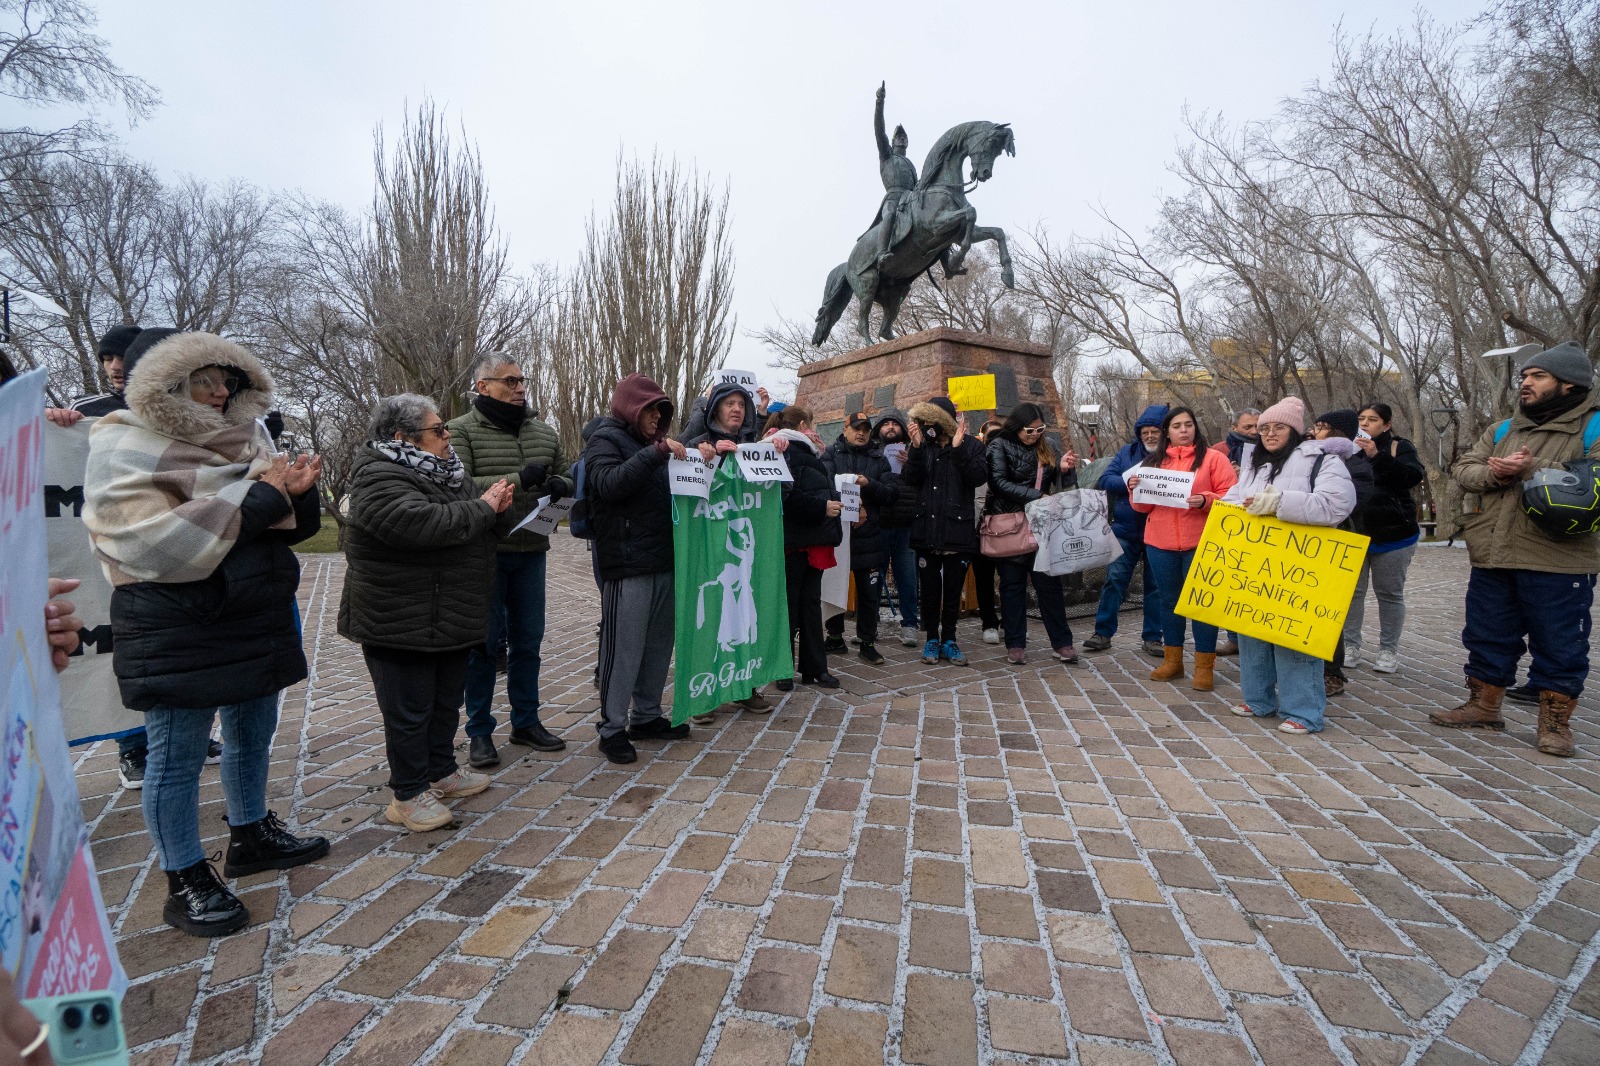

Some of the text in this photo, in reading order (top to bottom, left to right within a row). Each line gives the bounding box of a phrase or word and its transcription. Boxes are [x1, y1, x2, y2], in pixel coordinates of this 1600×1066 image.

[722, 375, 753, 385] NO AL
[955, 379, 988, 391] NO AL
[742, 450, 778, 461] NO AL
[750, 467, 783, 476] VETO
[1137, 473, 1190, 484] DISCAPACIDAD
[1139, 489, 1185, 499] EMERGENCIA
[1220, 514, 1362, 573] QUE NO TE
[1201, 541, 1319, 588] PASE A VOS
[1188, 587, 1214, 609] NO
[1193, 562, 1224, 587] NO
[1314, 604, 1346, 624] QUE
